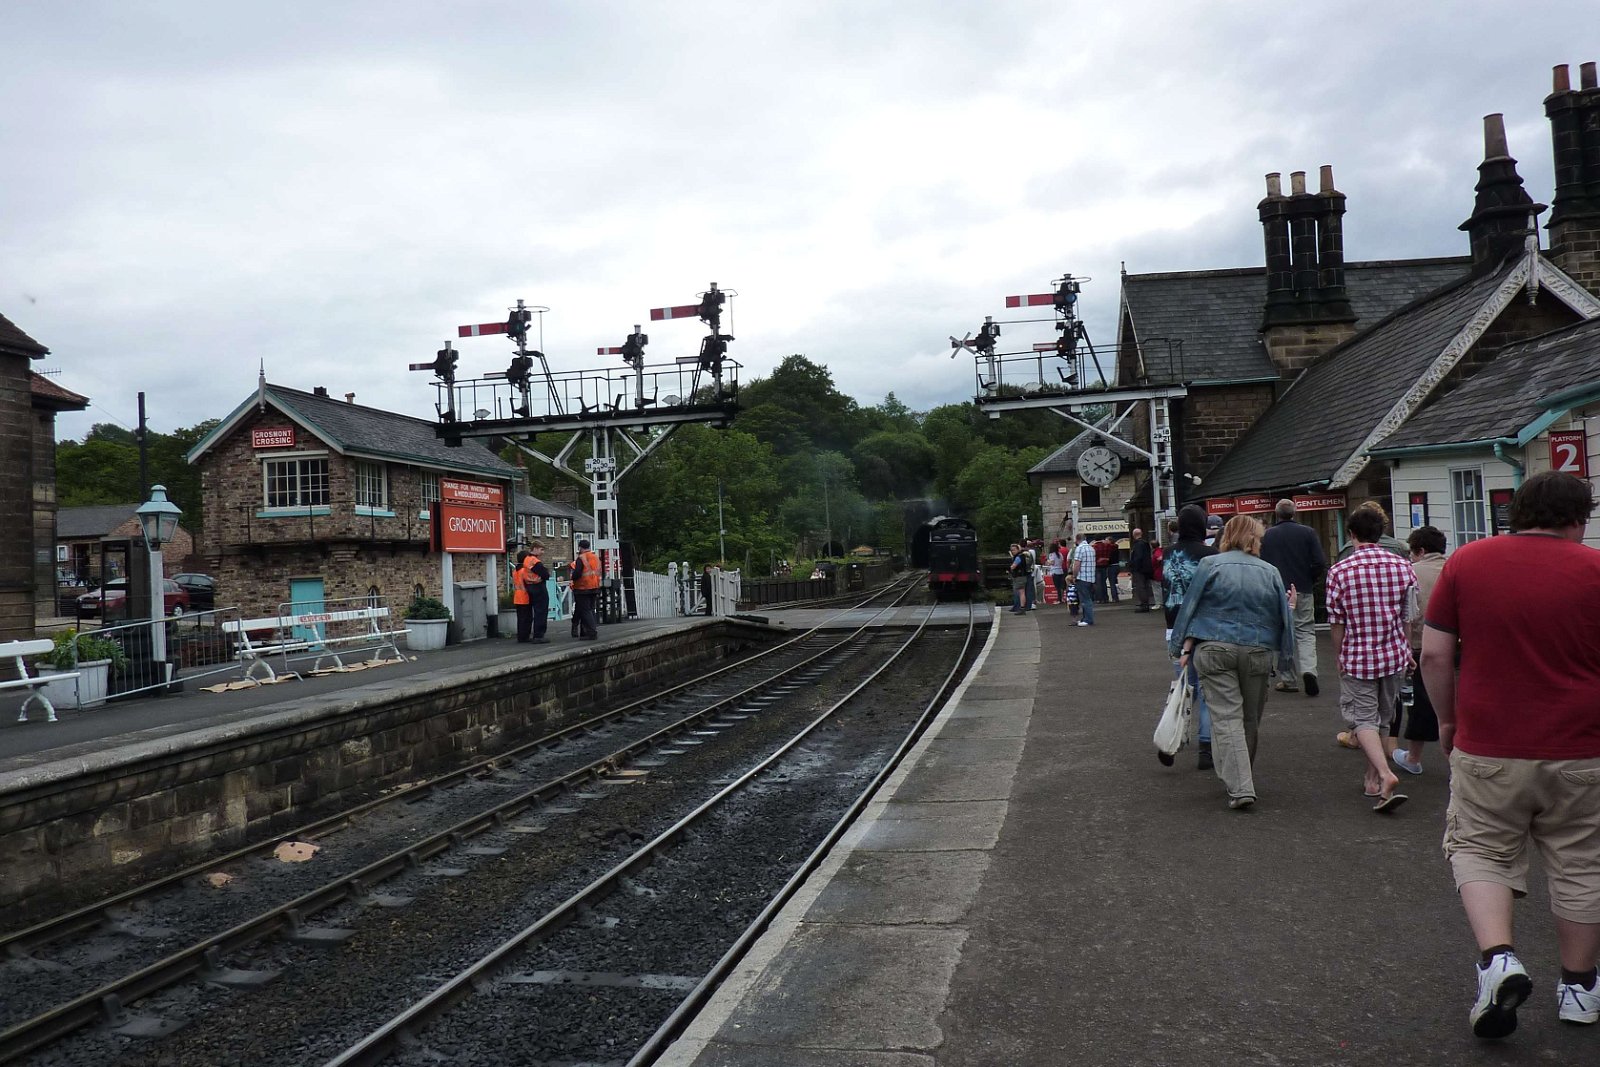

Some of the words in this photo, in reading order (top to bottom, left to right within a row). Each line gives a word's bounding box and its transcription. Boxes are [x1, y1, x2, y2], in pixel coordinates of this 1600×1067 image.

[255, 430, 292, 438] GROSMONT
[1556, 443, 1580, 472] 2
[460, 483, 469, 491] FOR
[487, 487, 501, 495] TOWN
[1295, 498, 1344, 507] GENTLEMEN
[448, 516, 497, 533] GROSMONT
